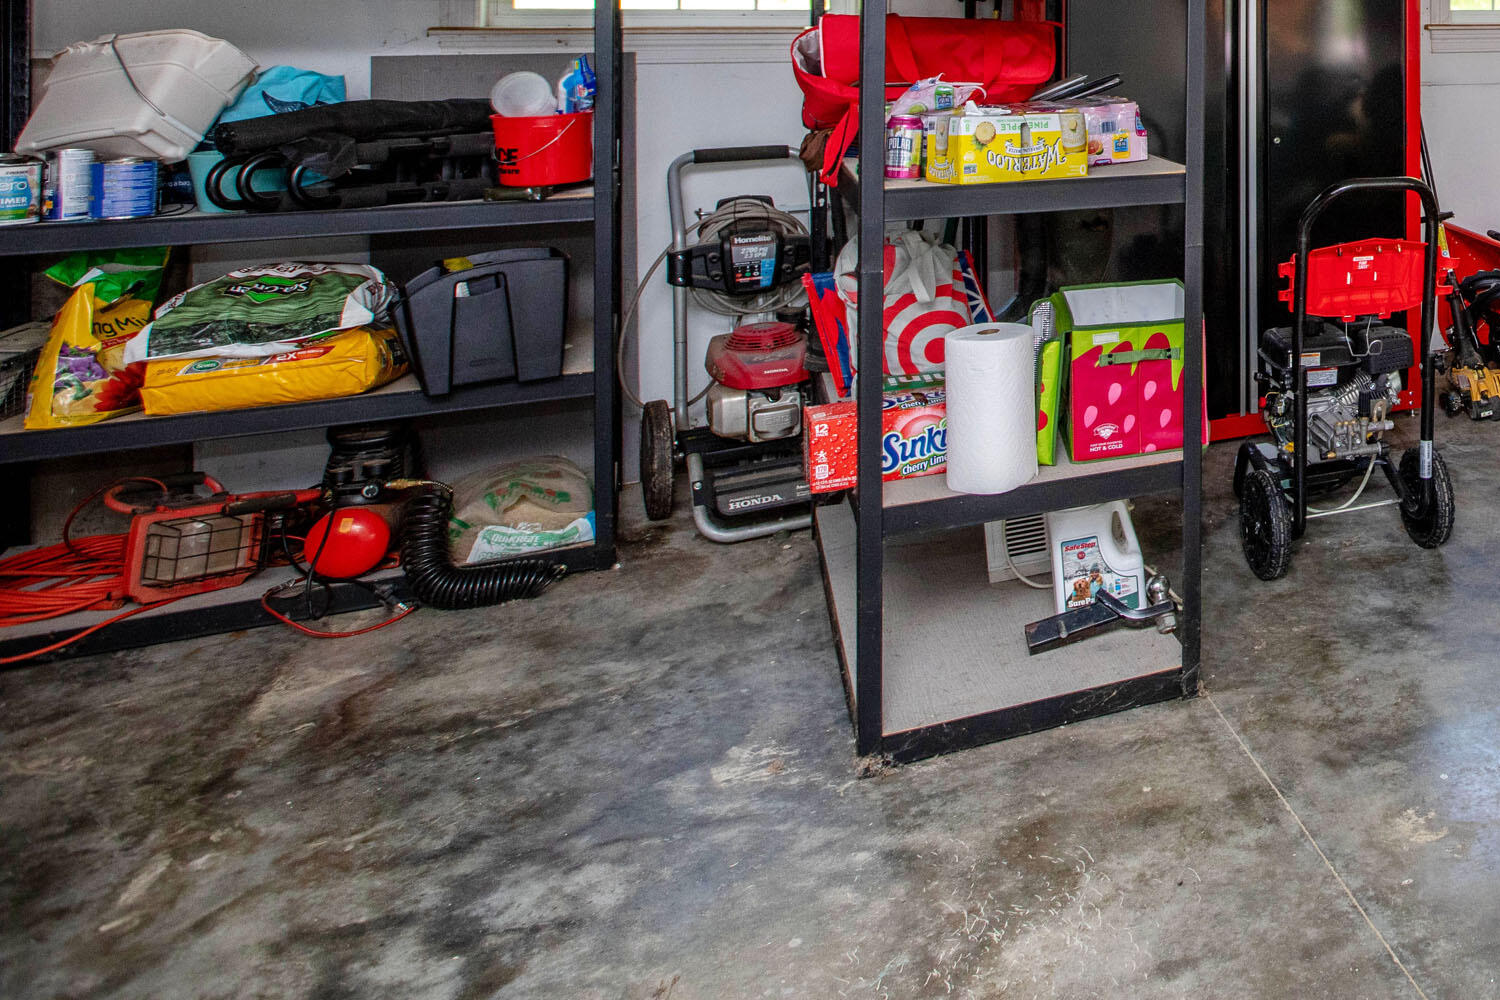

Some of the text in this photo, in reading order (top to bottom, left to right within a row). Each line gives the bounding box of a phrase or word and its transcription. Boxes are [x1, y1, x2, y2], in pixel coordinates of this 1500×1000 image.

[888, 136, 912, 150] POLAR
[496, 147, 519, 167] CE
[987, 137, 1067, 175] WATERLOO
[0, 181, 28, 191] ero
[0, 197, 28, 205] IMER
[734, 234, 772, 244] Homelite
[815, 424, 829, 433] 12
[881, 423, 947, 473] Sunki
[902, 460, 928, 475] Cherry
[728, 494, 783, 510] HONDA
